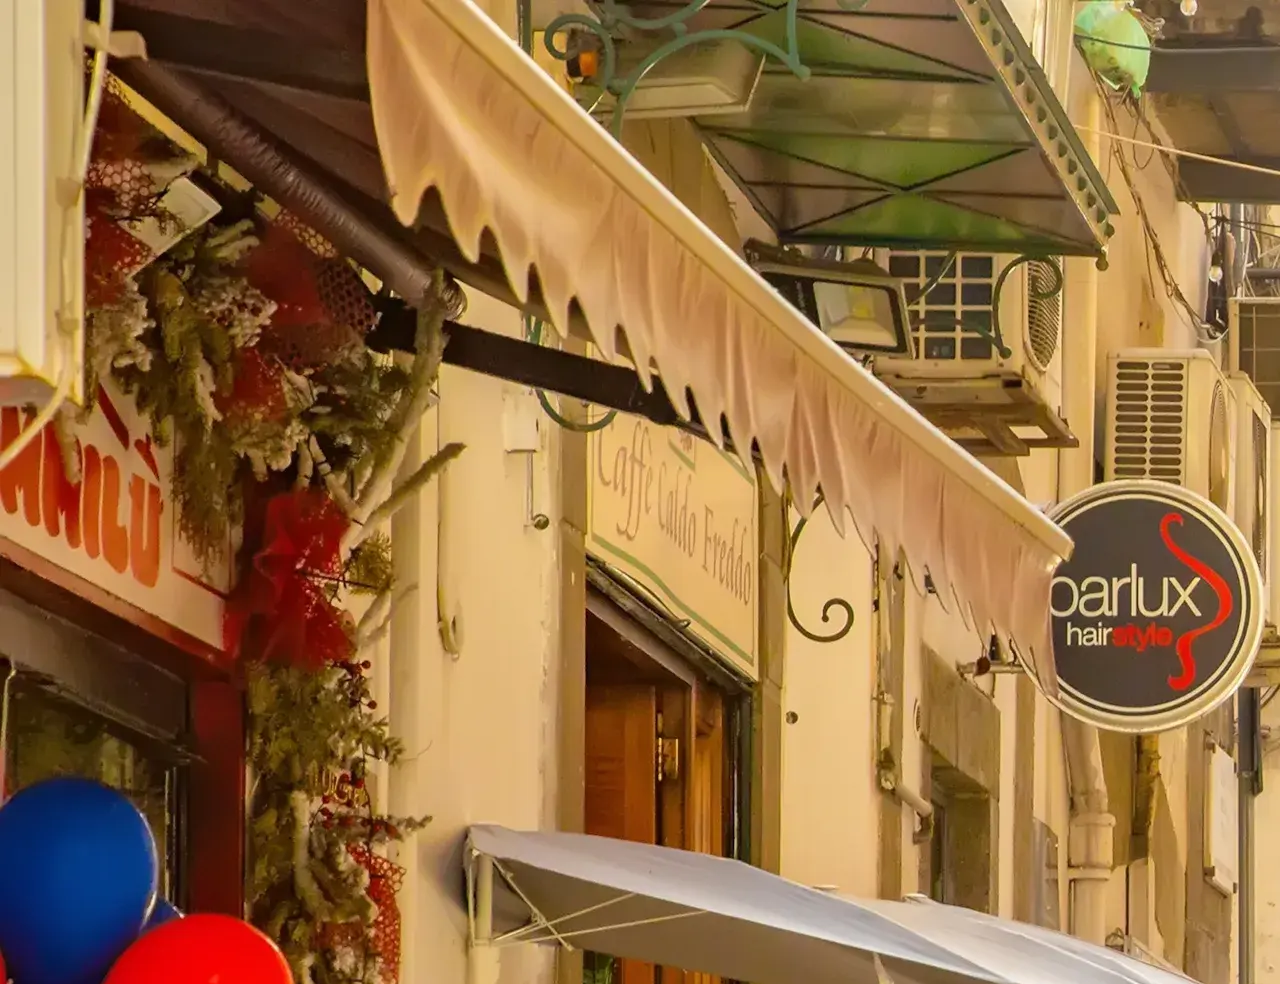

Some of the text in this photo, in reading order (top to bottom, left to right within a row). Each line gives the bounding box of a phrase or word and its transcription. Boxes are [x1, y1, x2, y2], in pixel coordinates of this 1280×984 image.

[658, 462, 697, 558] Caldo
[702, 503, 752, 606] Freddo
[1066, 622, 1174, 653] hairstyle
